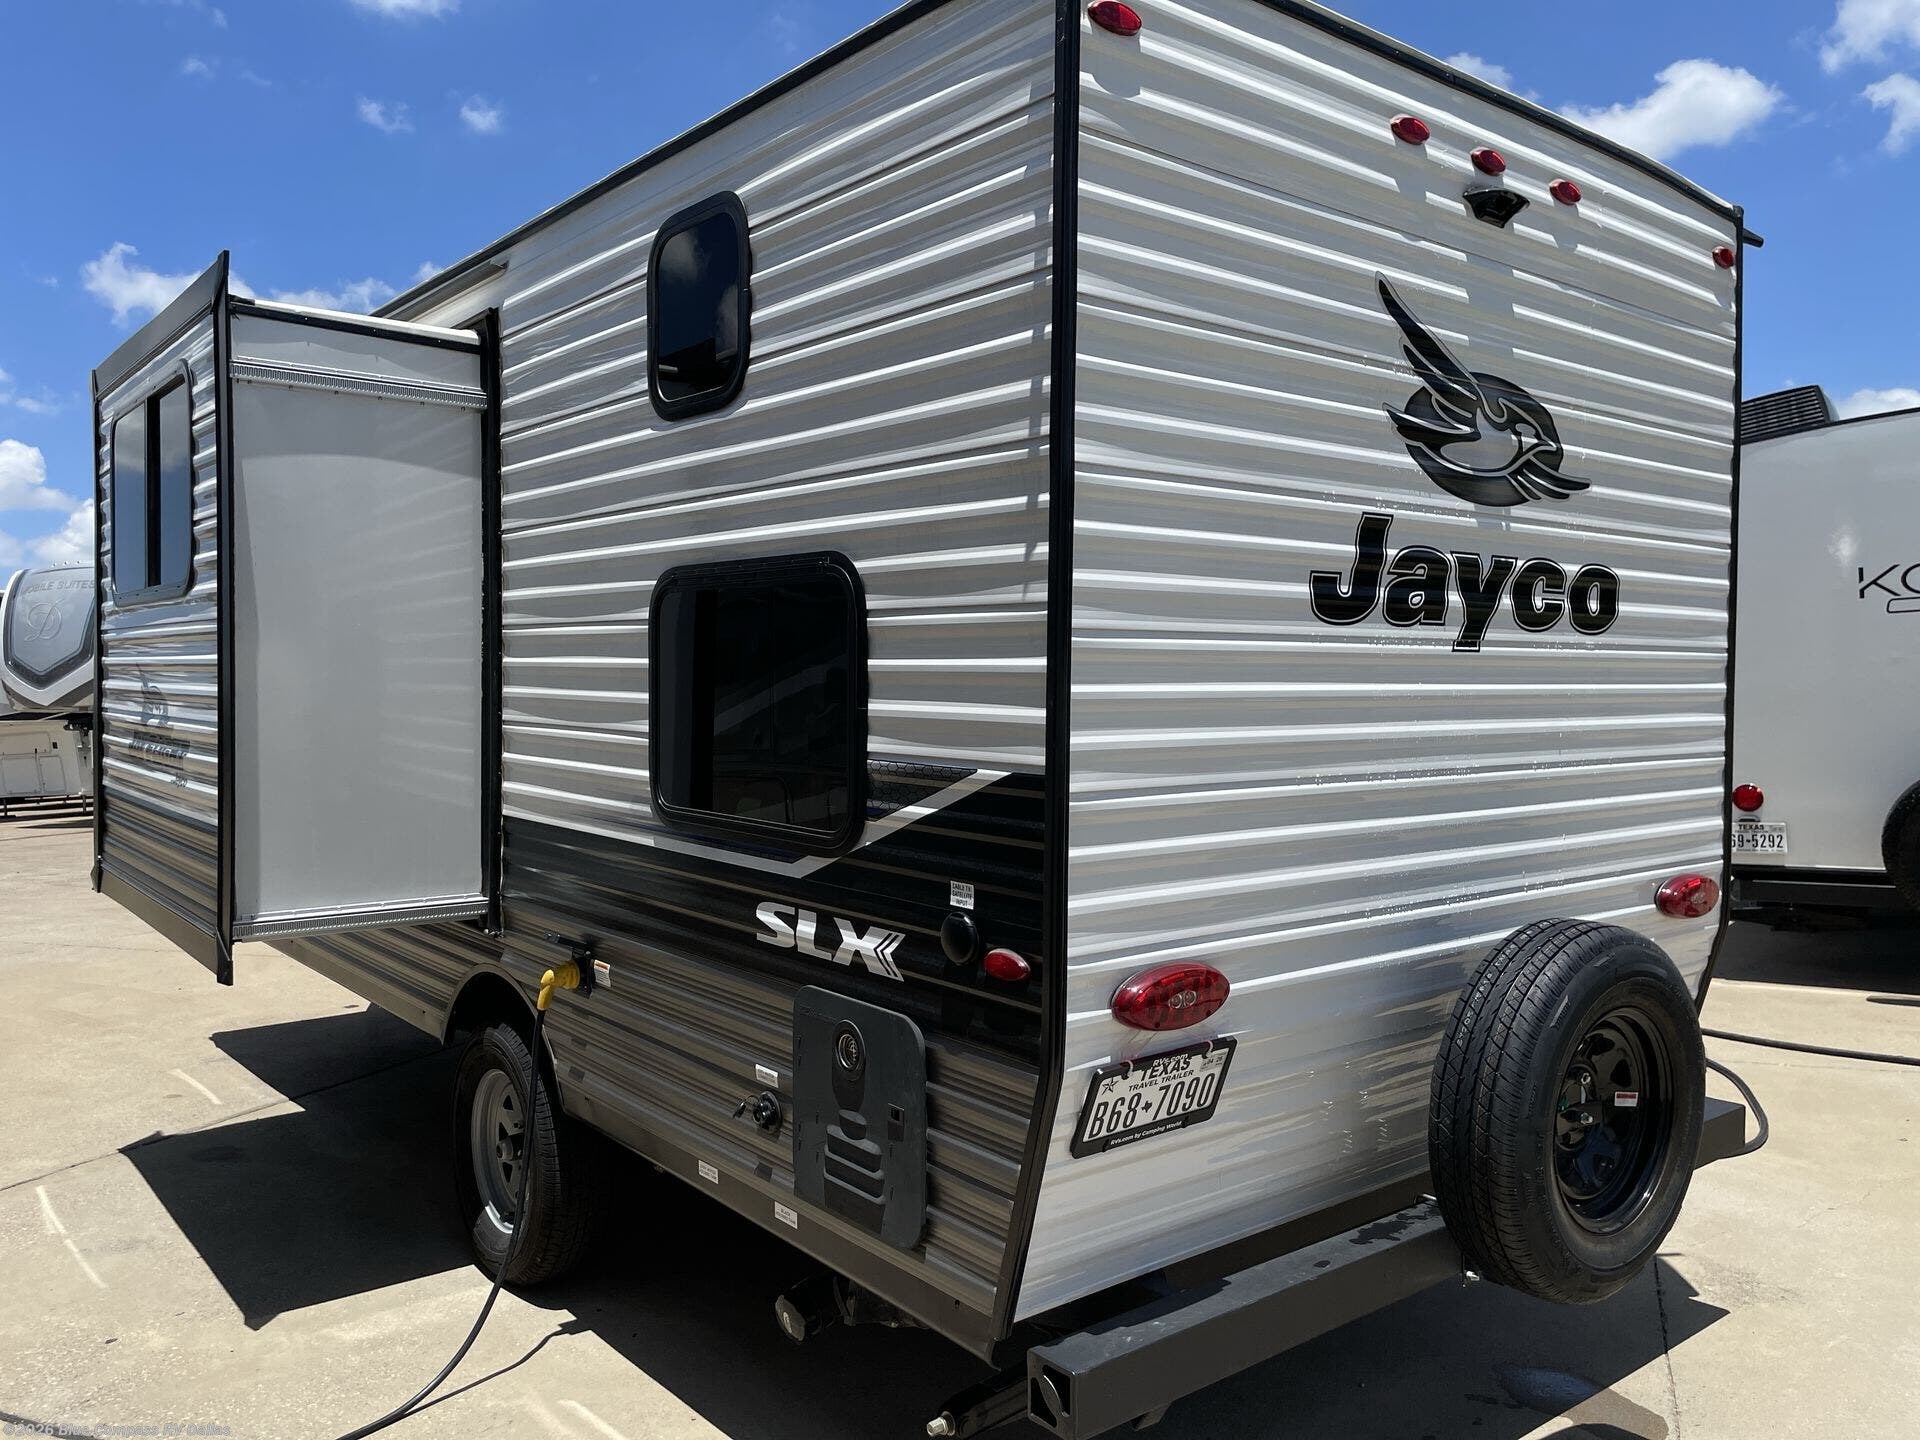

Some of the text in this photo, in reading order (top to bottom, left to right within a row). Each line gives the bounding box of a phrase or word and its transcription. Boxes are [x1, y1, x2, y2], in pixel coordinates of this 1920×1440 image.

[1309, 511, 1620, 653] Jayco
[1751, 833, 1783, 848] 5292
[755, 901, 905, 982] SLX
[1128, 1069, 1194, 1092] TRAVEL TRAILER
[1141, 1059, 1191, 1081] TEXAS
